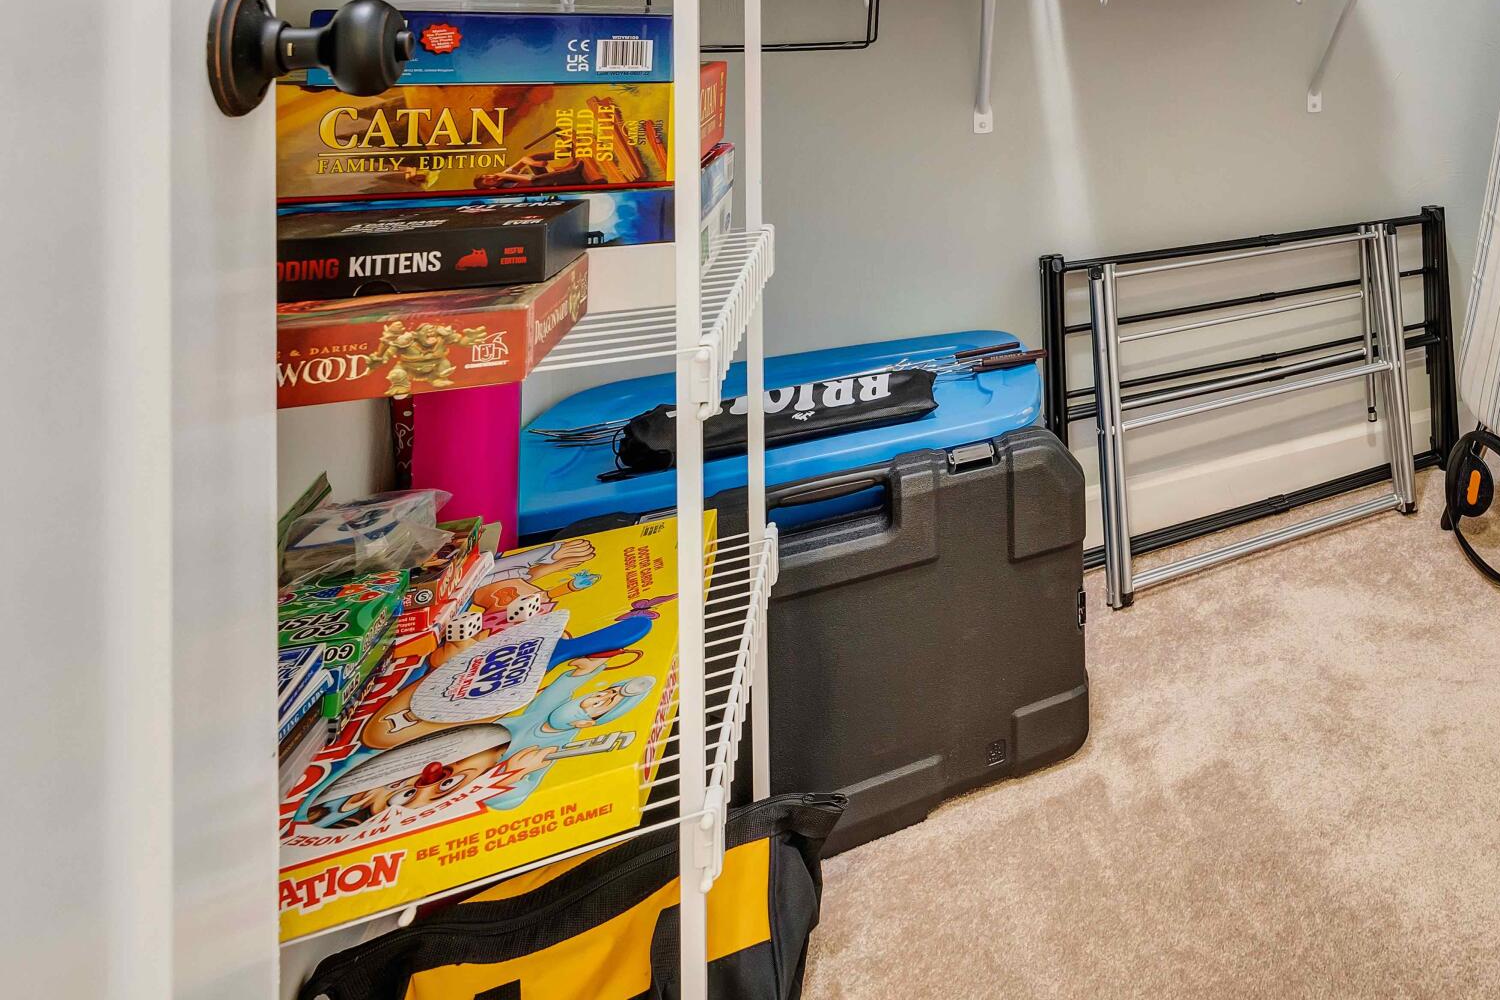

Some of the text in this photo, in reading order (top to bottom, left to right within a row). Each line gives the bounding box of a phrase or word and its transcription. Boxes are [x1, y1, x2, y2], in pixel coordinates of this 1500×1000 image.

[567, 54, 590, 63] UK
[567, 64, 589, 72] CA
[318, 107, 506, 150] CATAN
[555, 109, 574, 160] TRADE
[575, 108, 594, 159] BUILD
[596, 105, 616, 162] SETTLE
[317, 152, 507, 174] FAMILY EDITION
[348, 251, 441, 279] KITTENS
[310, 343, 368, 355] DARING
[469, 645, 518, 697] CARD
[502, 639, 541, 688] HOLDER
[399, 784, 482, 827] PRESS
[352, 824, 391, 842] MY
[416, 802, 578, 863] BE THE DOCTOR IN
[438, 804, 613, 868] THIS CLASSIC GAME!
